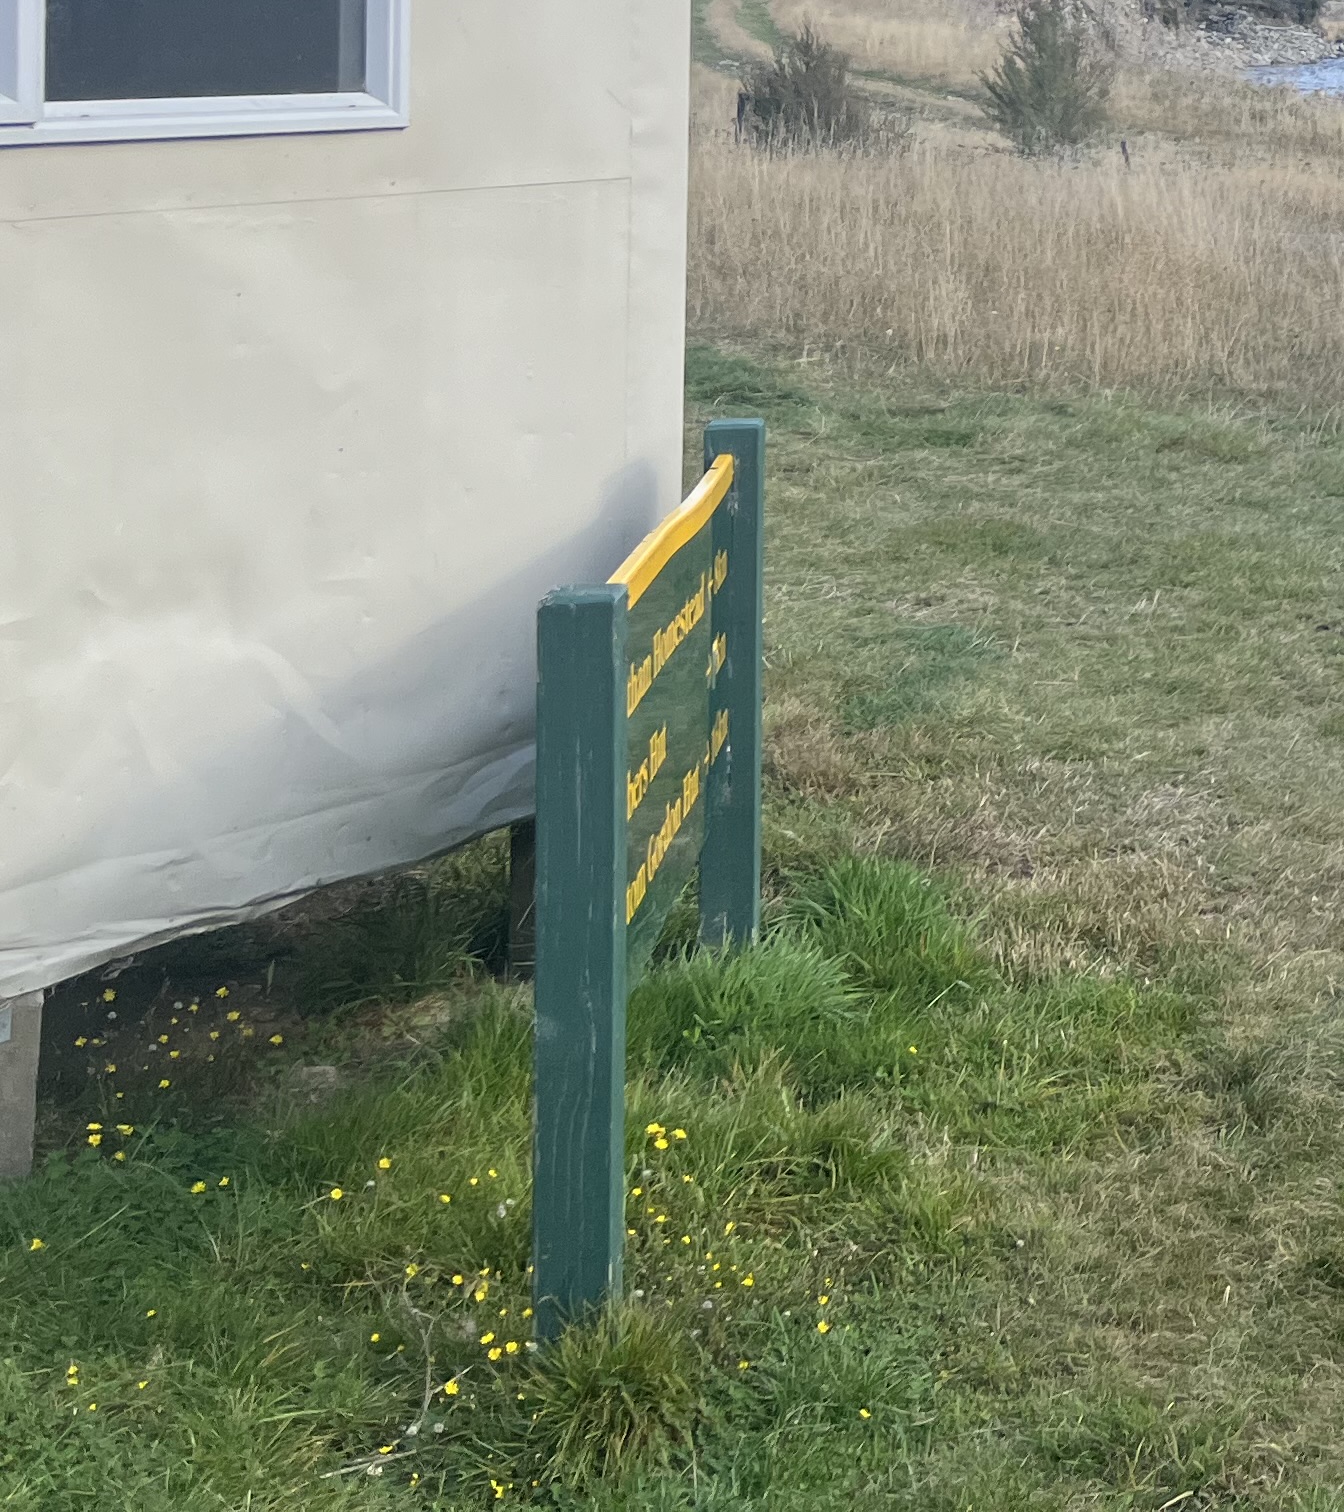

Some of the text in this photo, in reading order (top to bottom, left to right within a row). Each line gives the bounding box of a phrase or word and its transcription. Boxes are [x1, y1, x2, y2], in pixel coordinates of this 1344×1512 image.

[627, 655, 652, 719] tham
[653, 572, 705, 679] Homestead
[627, 757, 649, 822] bers
[650, 721, 667, 783] Hut
[647, 797, 682, 882] Gordon
[683, 760, 699, 819] Hut
